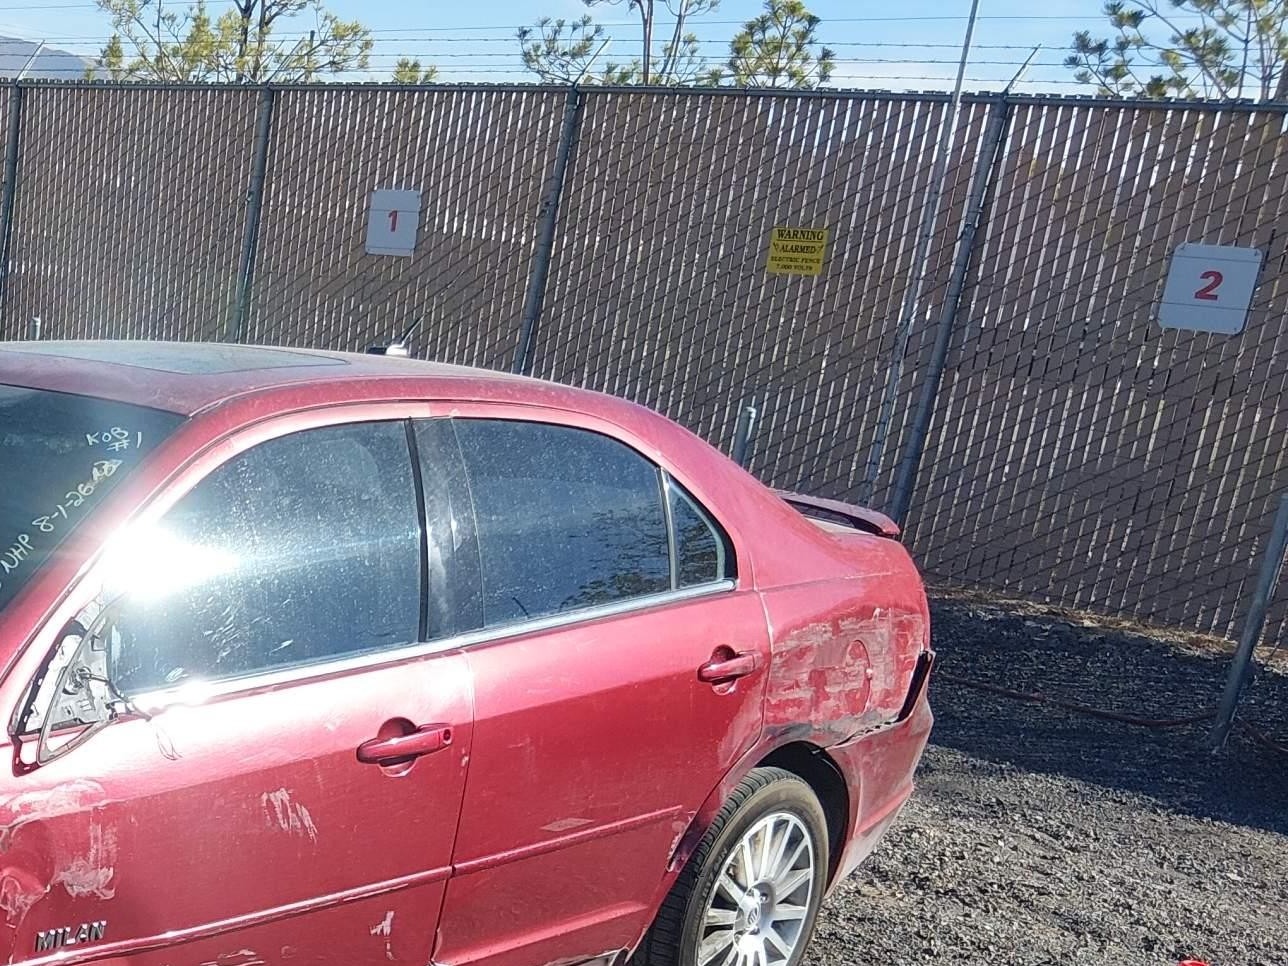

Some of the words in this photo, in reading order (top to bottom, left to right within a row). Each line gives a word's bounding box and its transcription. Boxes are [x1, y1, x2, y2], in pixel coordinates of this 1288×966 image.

[387, 209, 398, 233] 1
[777, 229, 824, 240] WARNING
[782, 244, 817, 253] ALARMED
[1193, 270, 1224, 301] 2
[0, 533, 35, 574] NHP
[34, 920, 107, 953] MILAN
